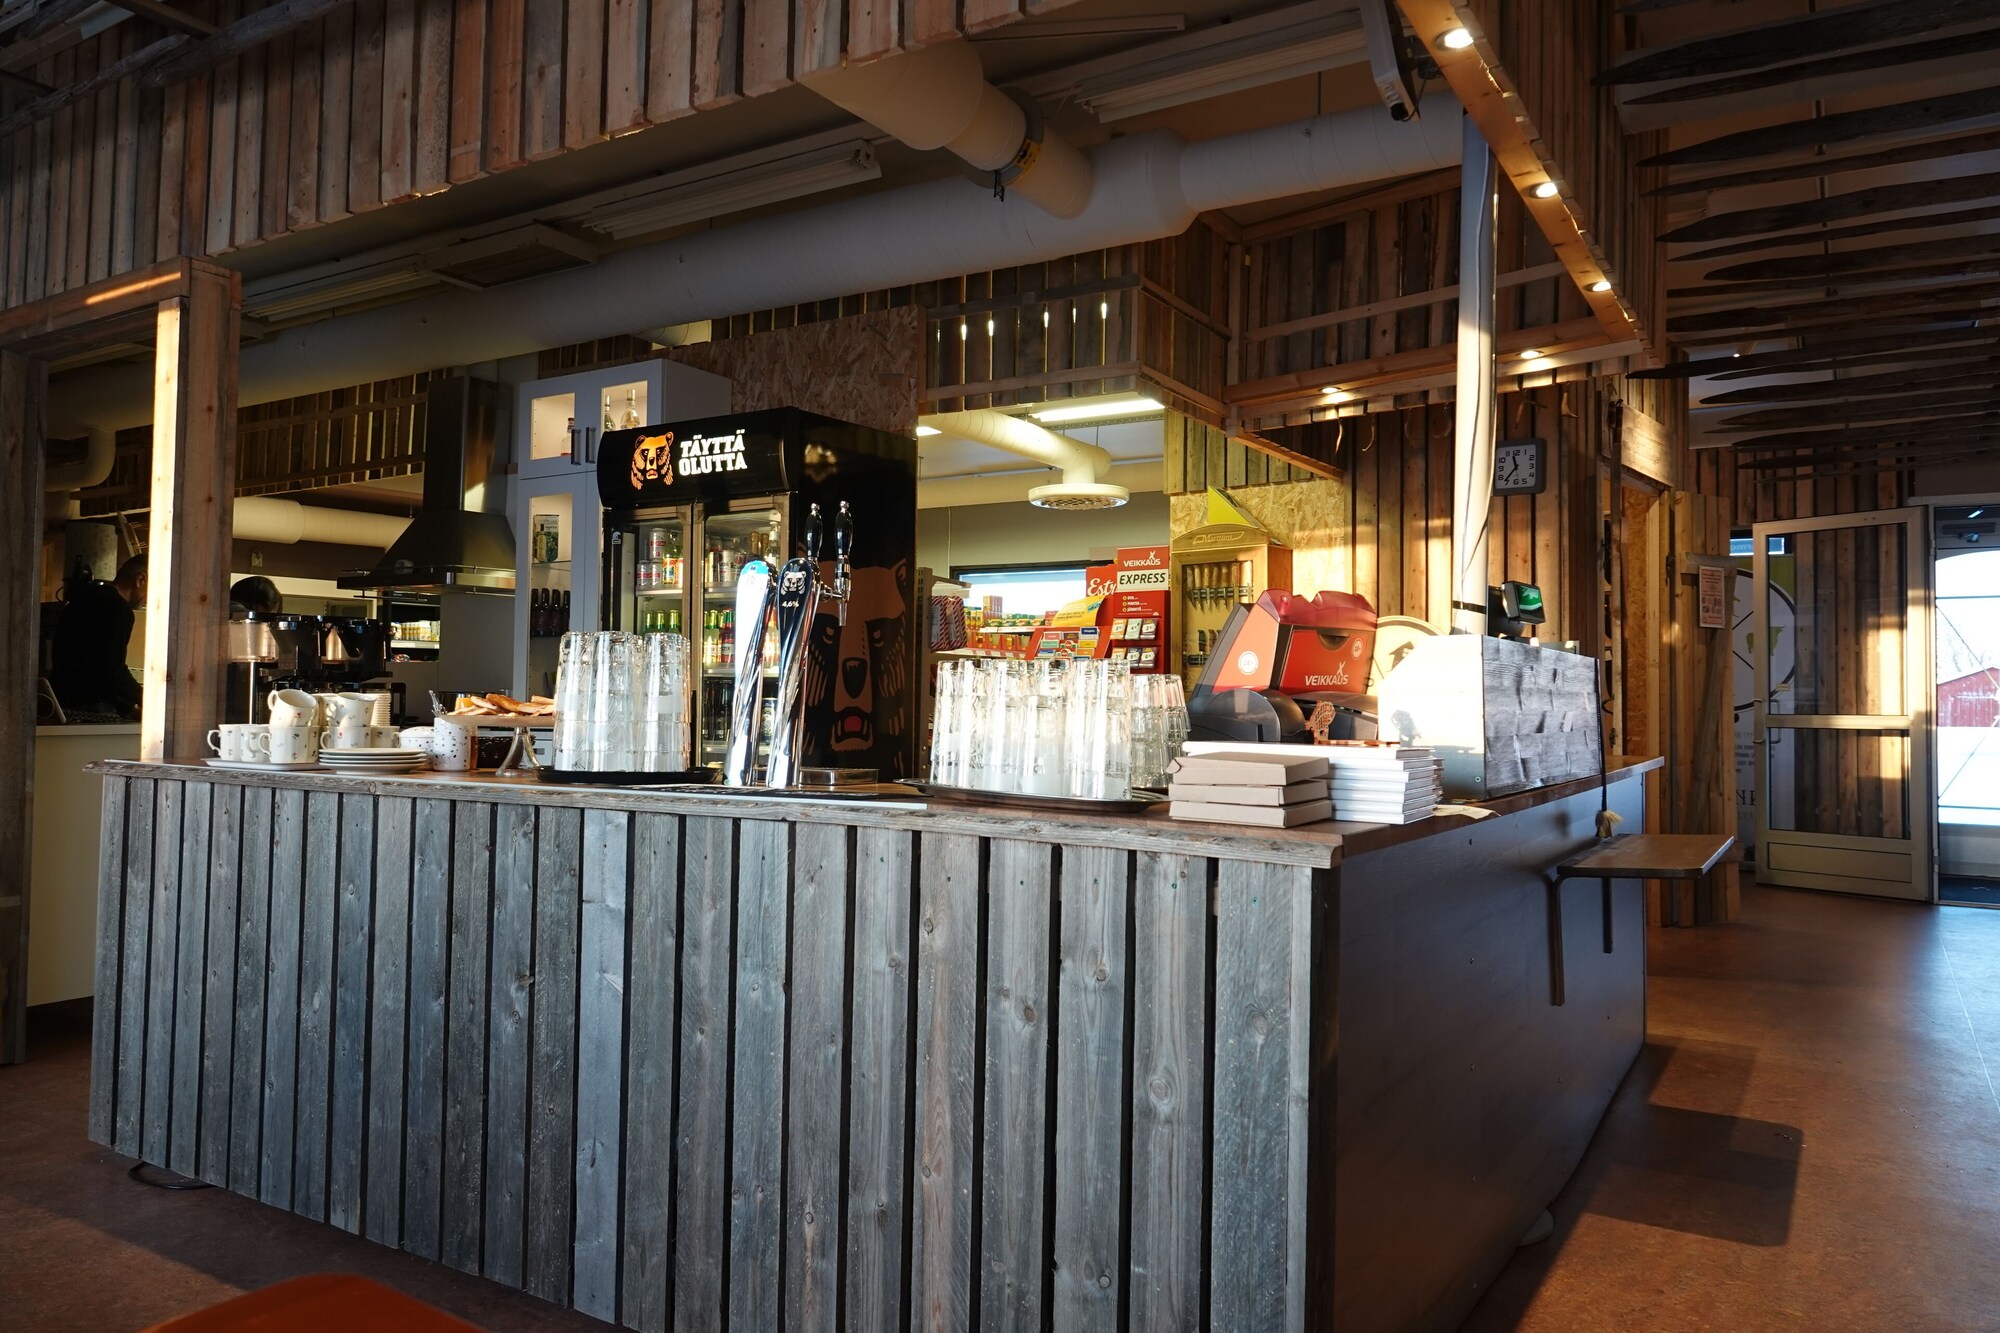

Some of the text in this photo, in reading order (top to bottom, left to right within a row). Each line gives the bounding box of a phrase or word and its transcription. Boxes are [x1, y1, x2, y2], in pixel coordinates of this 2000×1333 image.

[680, 429, 745, 457] TÄYTTÄ
[678, 452, 748, 476] OLUTTA
[1123, 556, 1161, 567] VEIKKAUS
[1119, 572, 1166, 585] EXPRESS
[782, 600, 799, 608] 4,6%
[1305, 670, 1349, 686] VEIKKAUS
